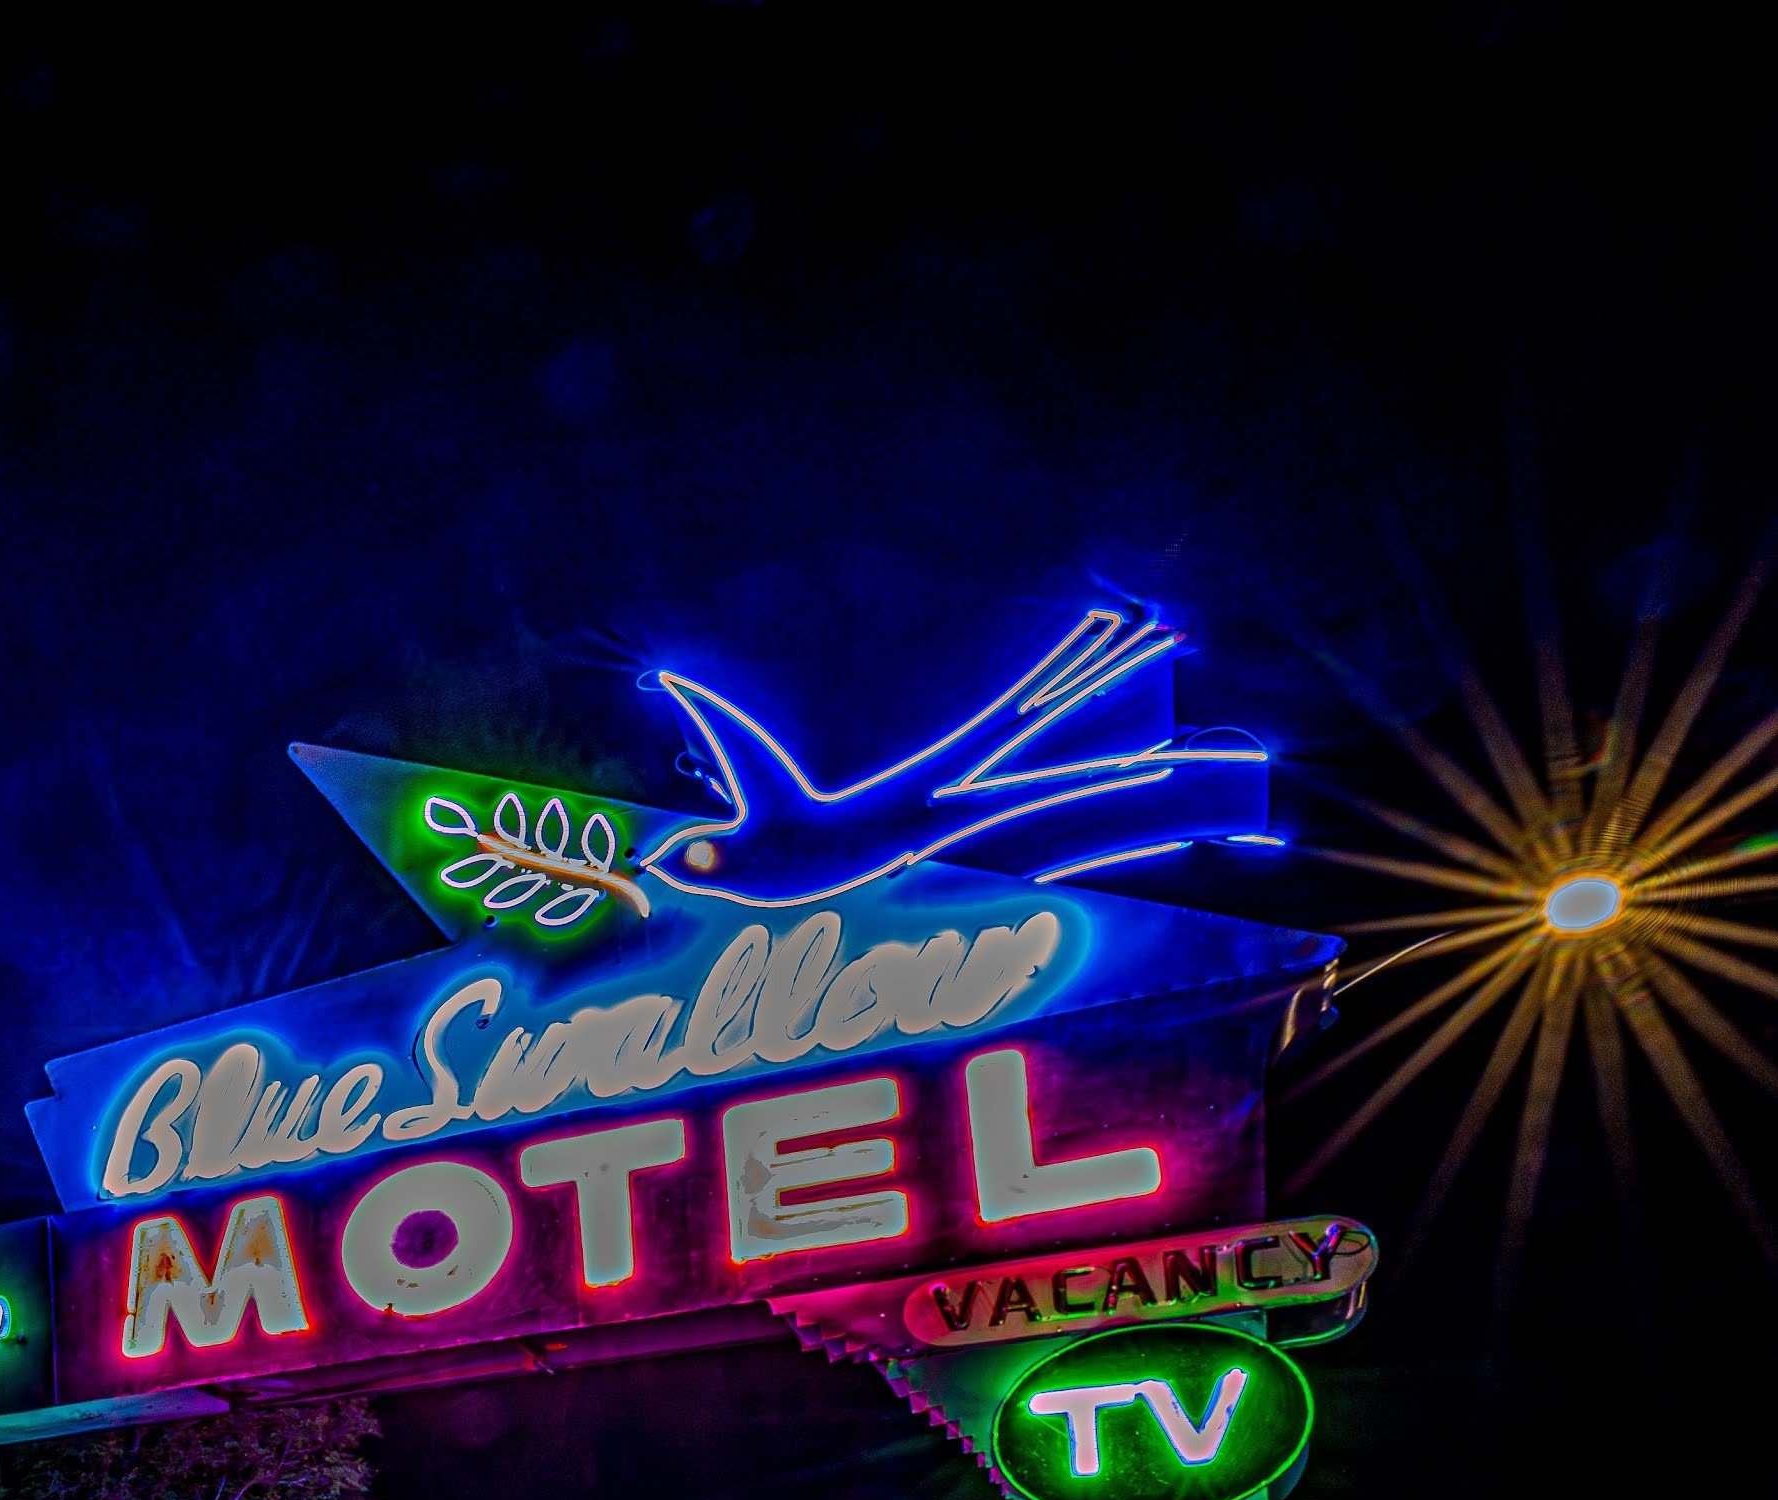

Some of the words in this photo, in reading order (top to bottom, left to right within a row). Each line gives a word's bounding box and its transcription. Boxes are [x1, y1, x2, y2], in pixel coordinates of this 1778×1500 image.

[101, 1040, 383, 1198] Blue
[382, 910, 1059, 1142] Swallow
[119, 1047, 1163, 1359] MOTEL
[930, 1222, 1344, 1331] VACANCY
[1028, 1367, 1248, 1477] TV
